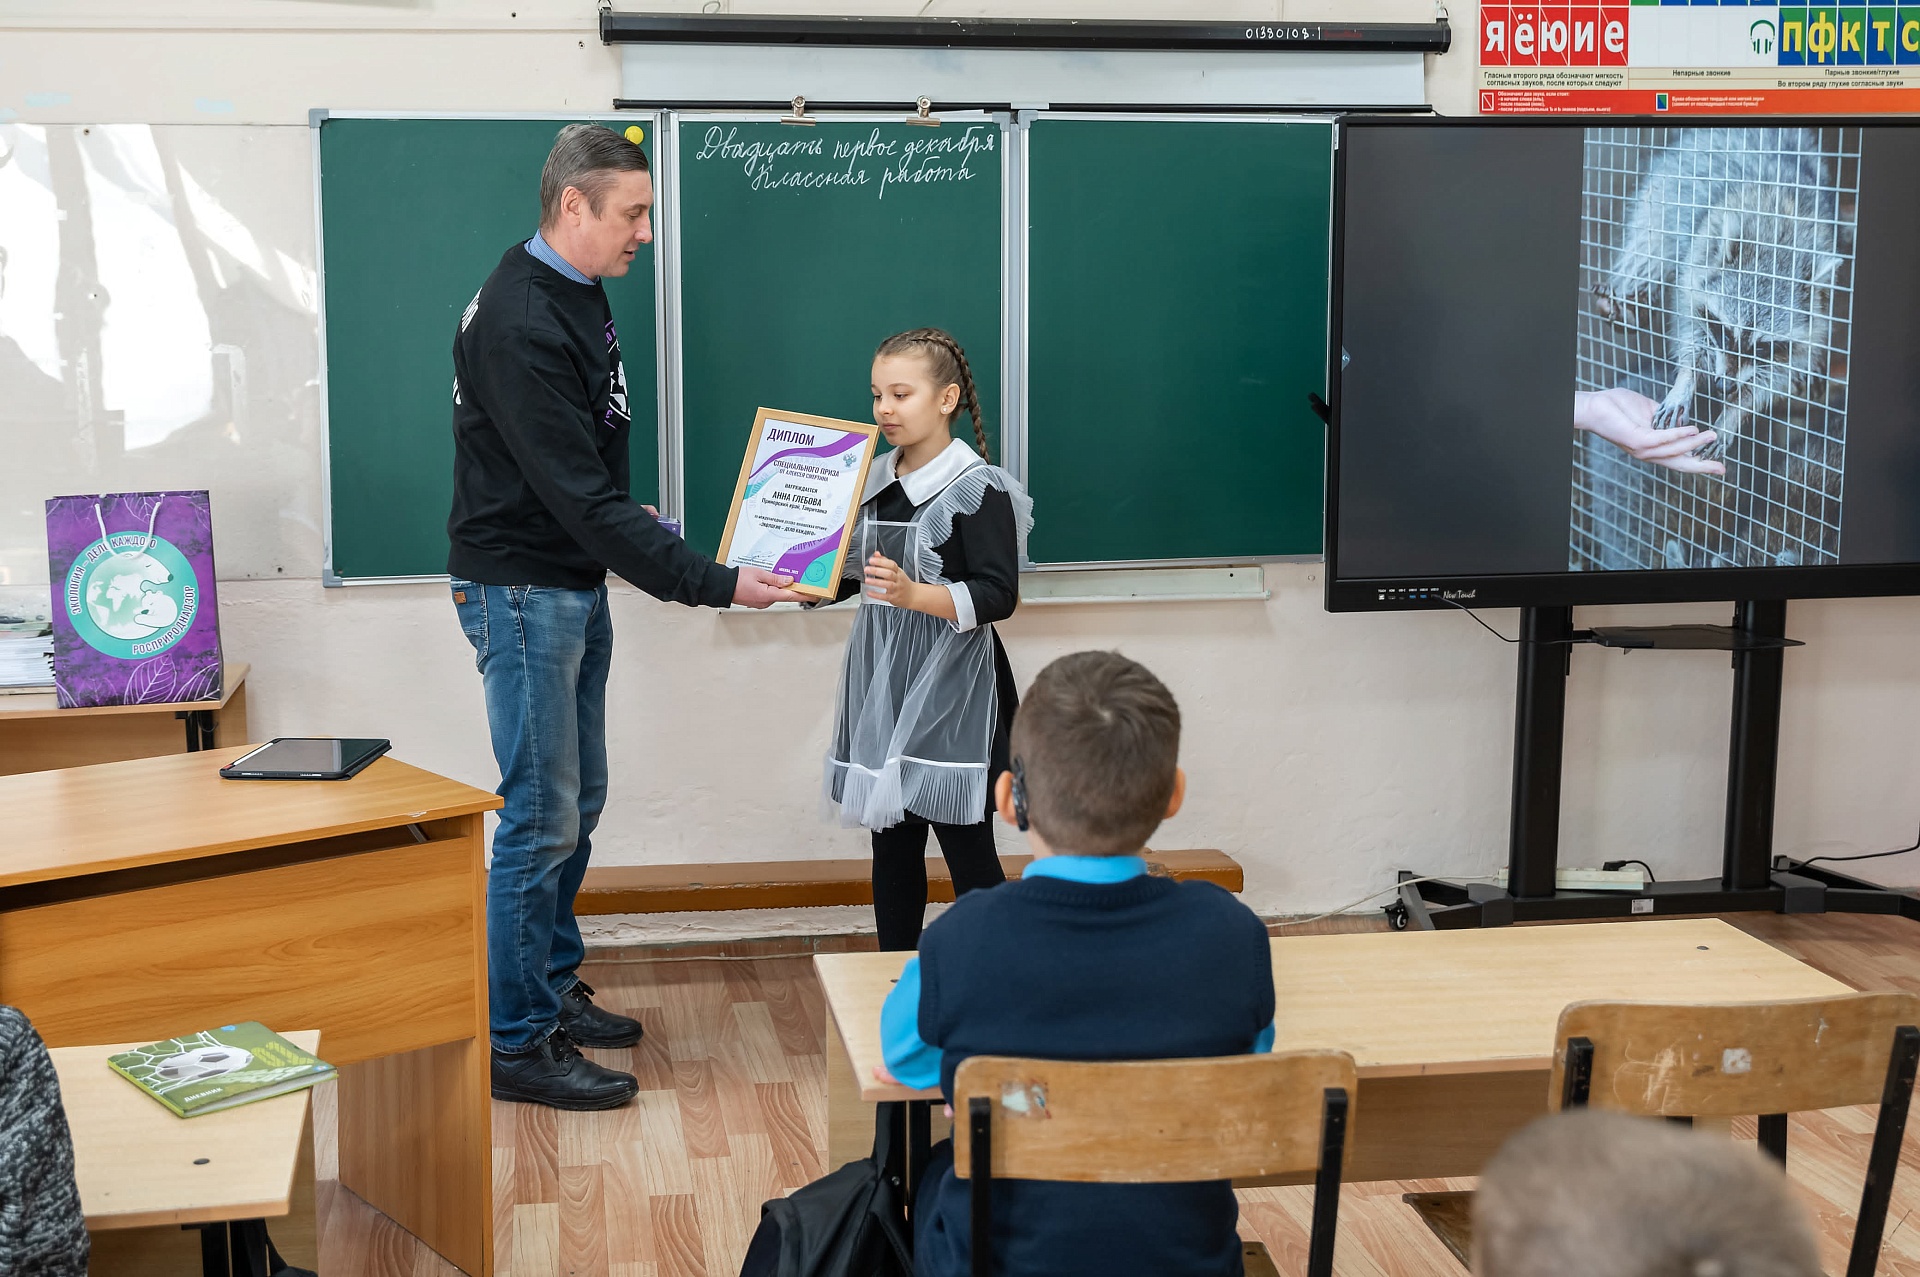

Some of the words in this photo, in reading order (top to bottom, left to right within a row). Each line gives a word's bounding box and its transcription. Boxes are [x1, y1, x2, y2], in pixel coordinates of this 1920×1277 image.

[696, 126, 824, 176] Двадцать
[833, 128, 898, 176] первое
[899, 126, 995, 169] декабря
[752, 162, 871, 191] Классная
[879, 156, 976, 200] работа
[766, 428, 815, 446] ДИПЛОМ
[774, 460, 820, 474] СПЕЦИАЛЬНОГО
[820, 468, 840, 477] ПРИЗА
[772, 491, 790, 501] АННА
[792, 494, 822, 506] ГЛЕБОВА
[68, 566, 86, 616] ЭКОЛОГИЯ
[111, 536, 157, 548] КАЖДОО
[132, 586, 196, 655] РОСПРИРОДНАДЗОР
[184, 1087, 223, 1102] ДНЕВНИК
